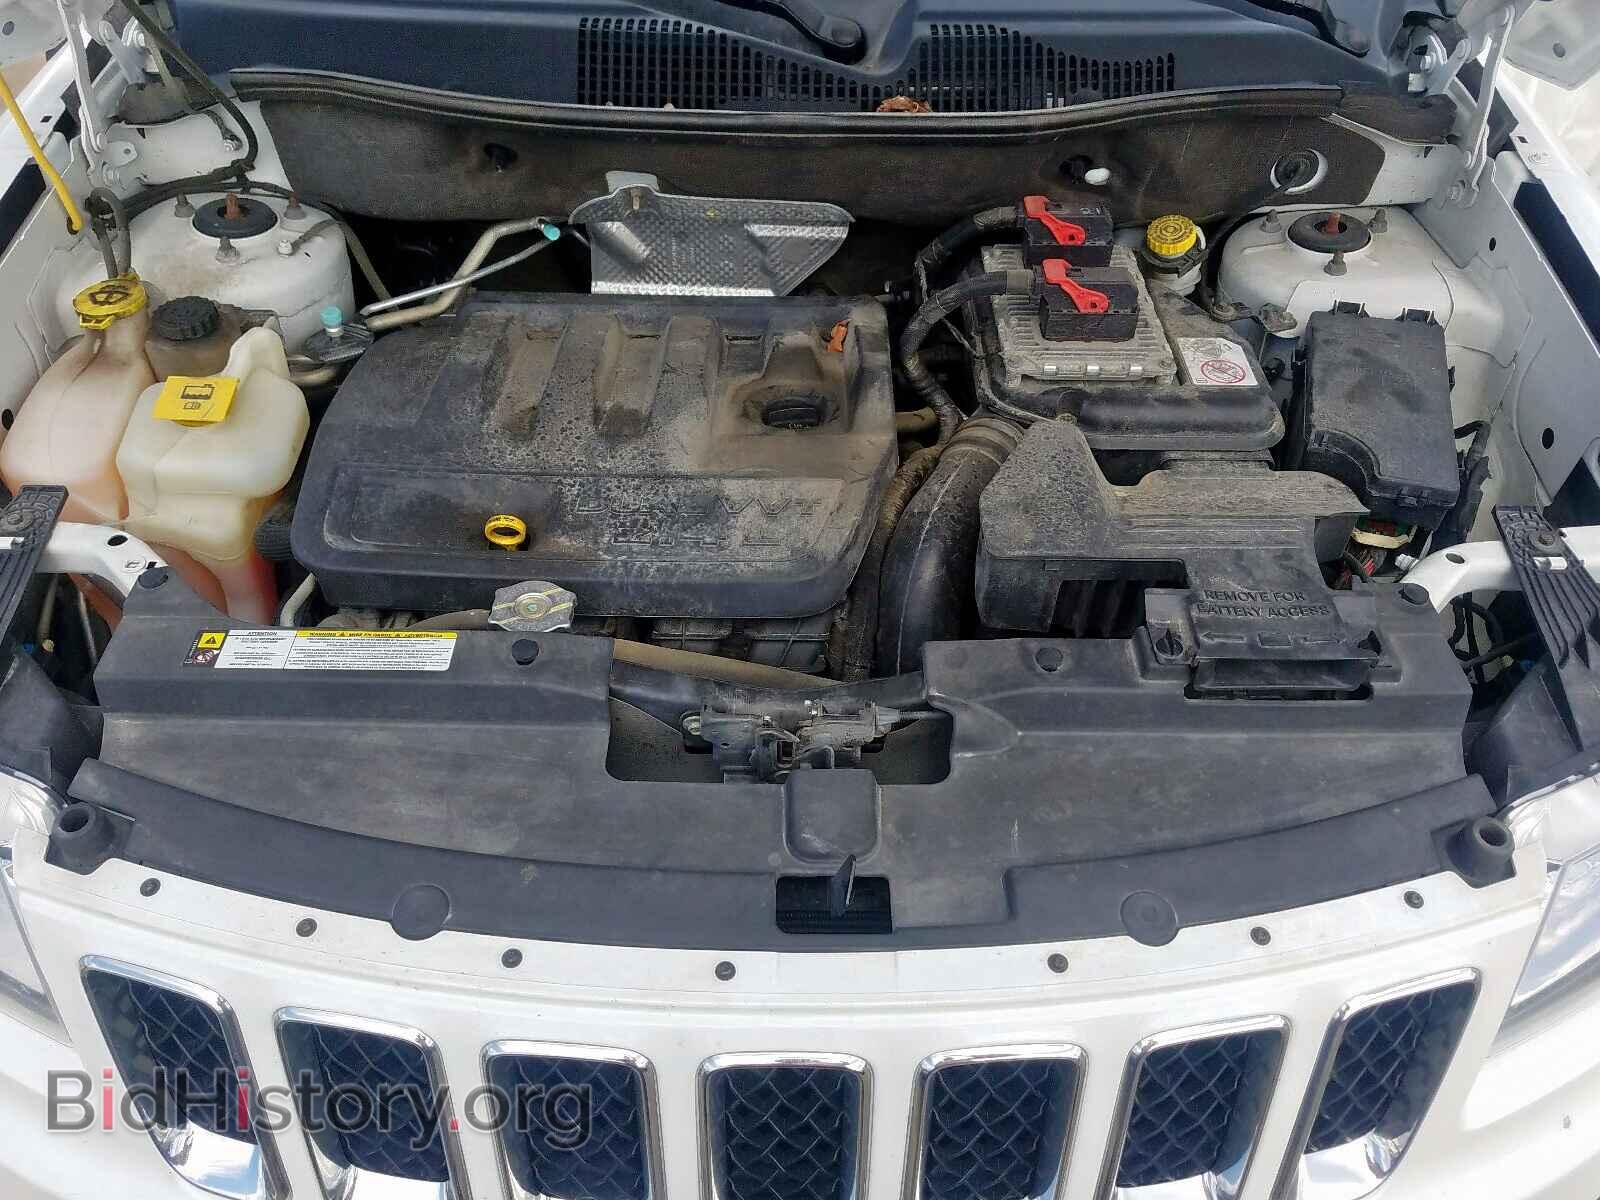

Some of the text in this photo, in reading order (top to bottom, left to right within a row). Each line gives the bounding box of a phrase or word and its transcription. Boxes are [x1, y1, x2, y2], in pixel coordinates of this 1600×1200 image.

[1203, 589, 1305, 601] REMOVE FOR
[1197, 603, 1329, 617] BATTERY ACCESS
